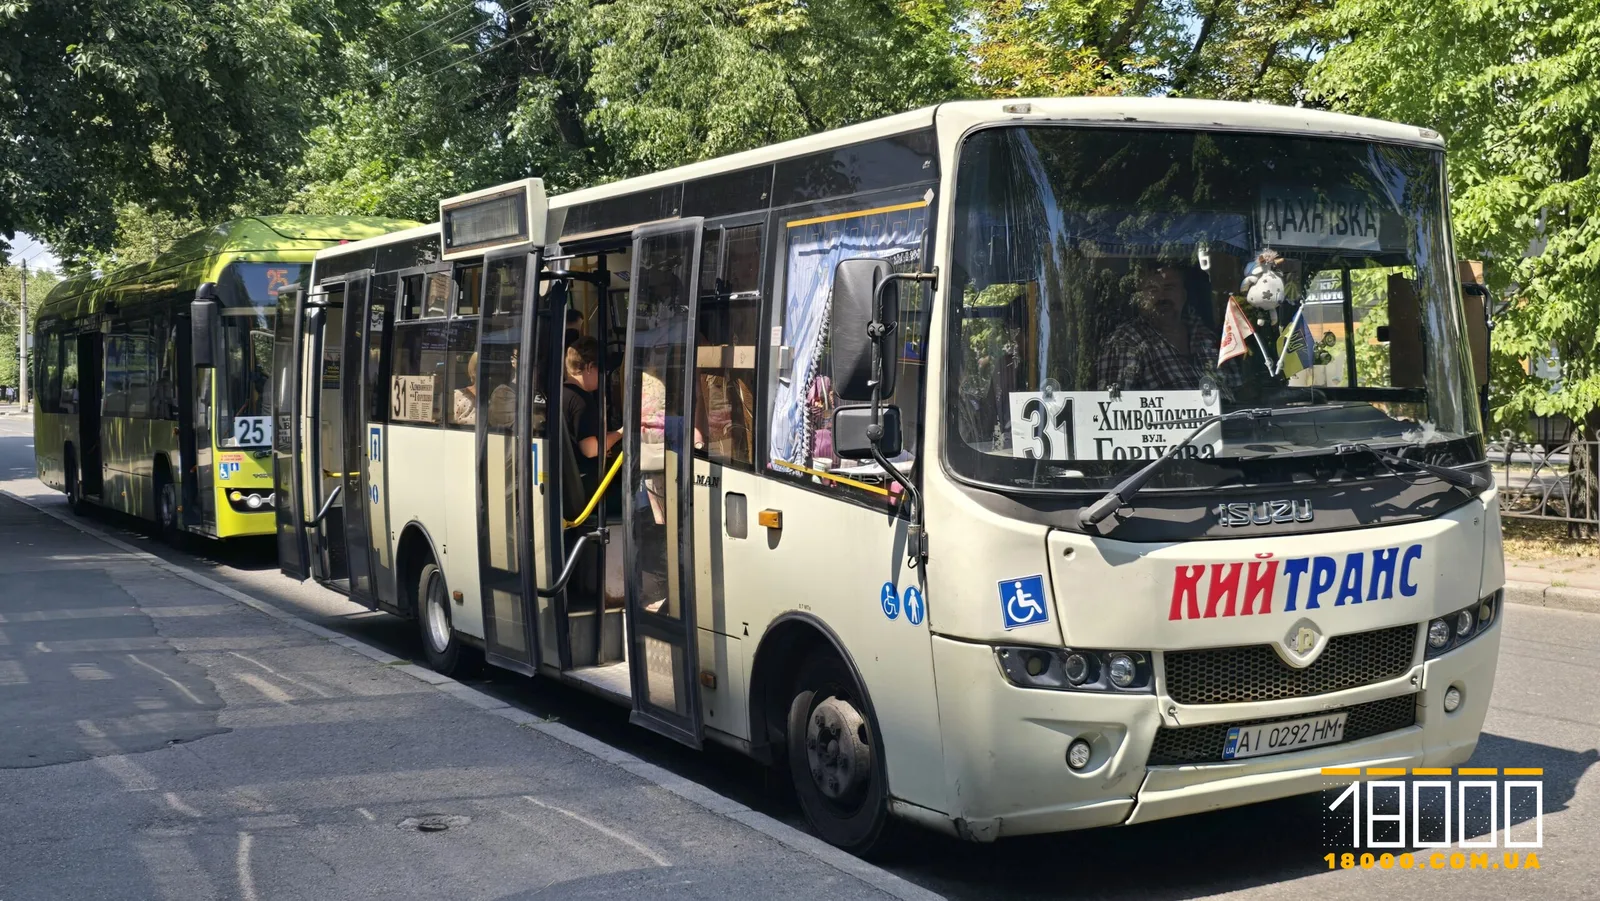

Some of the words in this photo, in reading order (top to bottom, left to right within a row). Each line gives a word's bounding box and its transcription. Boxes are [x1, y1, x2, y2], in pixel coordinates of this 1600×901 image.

[1263, 199, 1377, 240] ДАХНІВКА
[267, 269, 288, 296] 25
[394, 380, 406, 417] 31
[1140, 397, 1164, 409] ВАТ
[238, 419, 264, 444] 25
[1021, 397, 1078, 460] 31
[694, 474, 720, 488] MAN
[1219, 499, 1313, 527] ISUZU
[1269, 723, 1310, 748] 0292
[1312, 718, 1339, 741] HM
